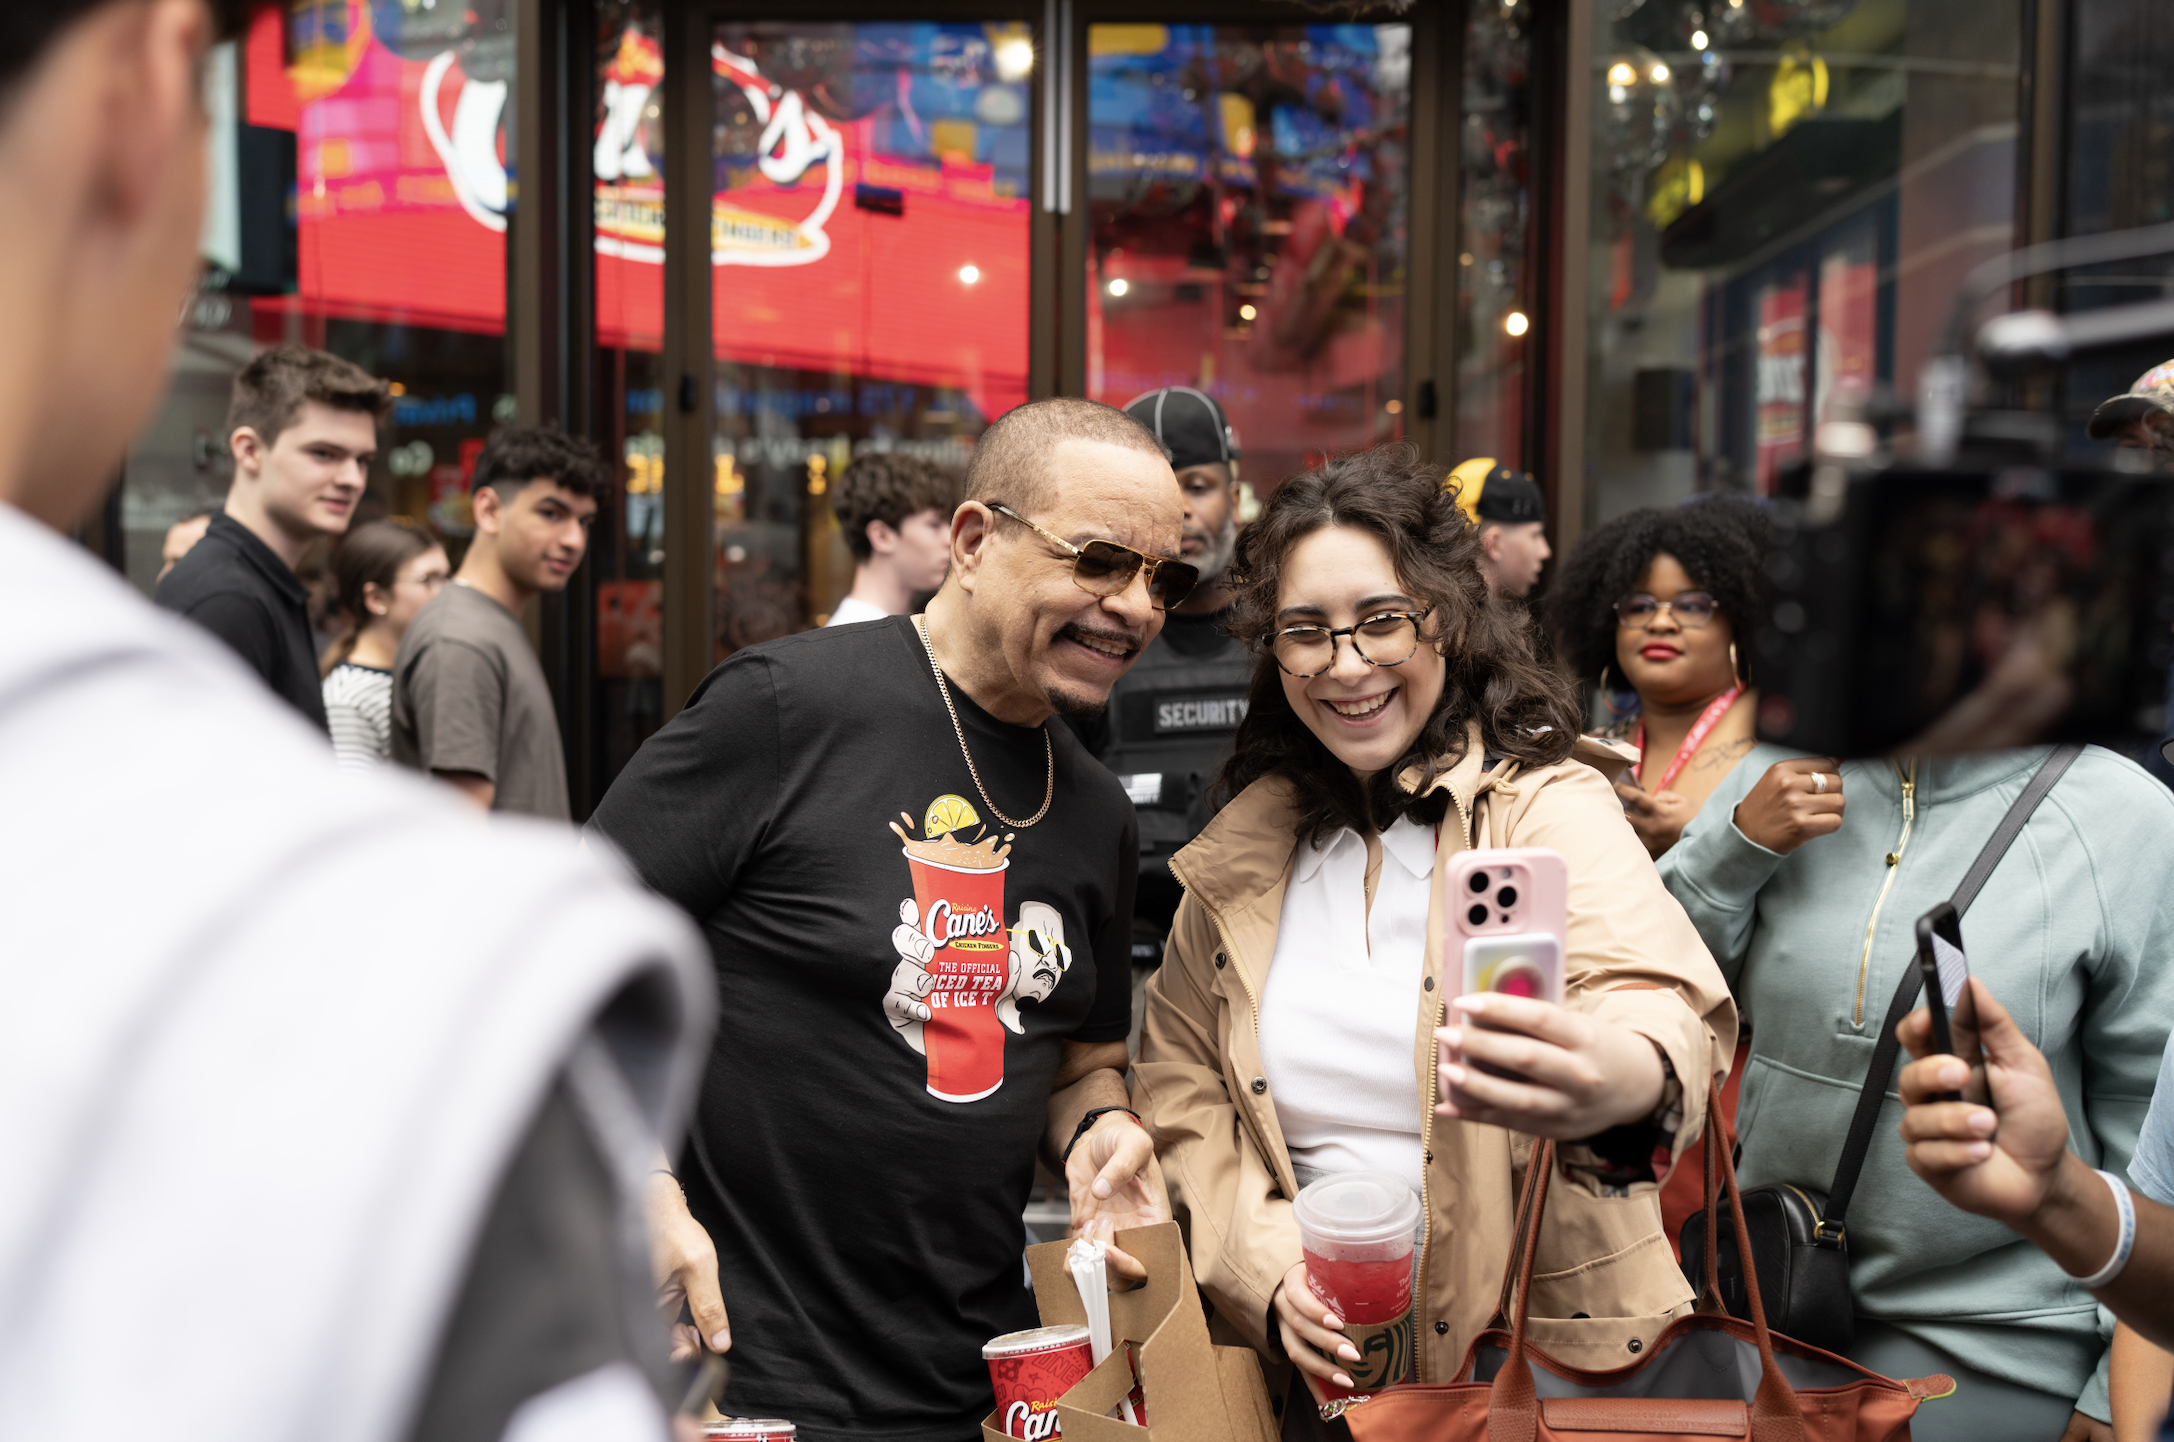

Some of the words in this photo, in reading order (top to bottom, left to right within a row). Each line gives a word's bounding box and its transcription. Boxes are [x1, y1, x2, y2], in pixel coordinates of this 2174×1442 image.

[1159, 699, 1250, 727] SECURITY
[952, 903, 977, 914] Raising
[926, 899, 1001, 949] Cane's
[939, 962, 957, 972] THE
[961, 963, 1000, 974] OFFICIAL
[971, 976, 1002, 990] TEA
[931, 992, 949, 1008] OF
[954, 991, 979, 1007] ICE
[982, 992, 994, 1005] T
[1031, 1398, 1058, 1412] Raisi
[1006, 1400, 1062, 1442] Can
